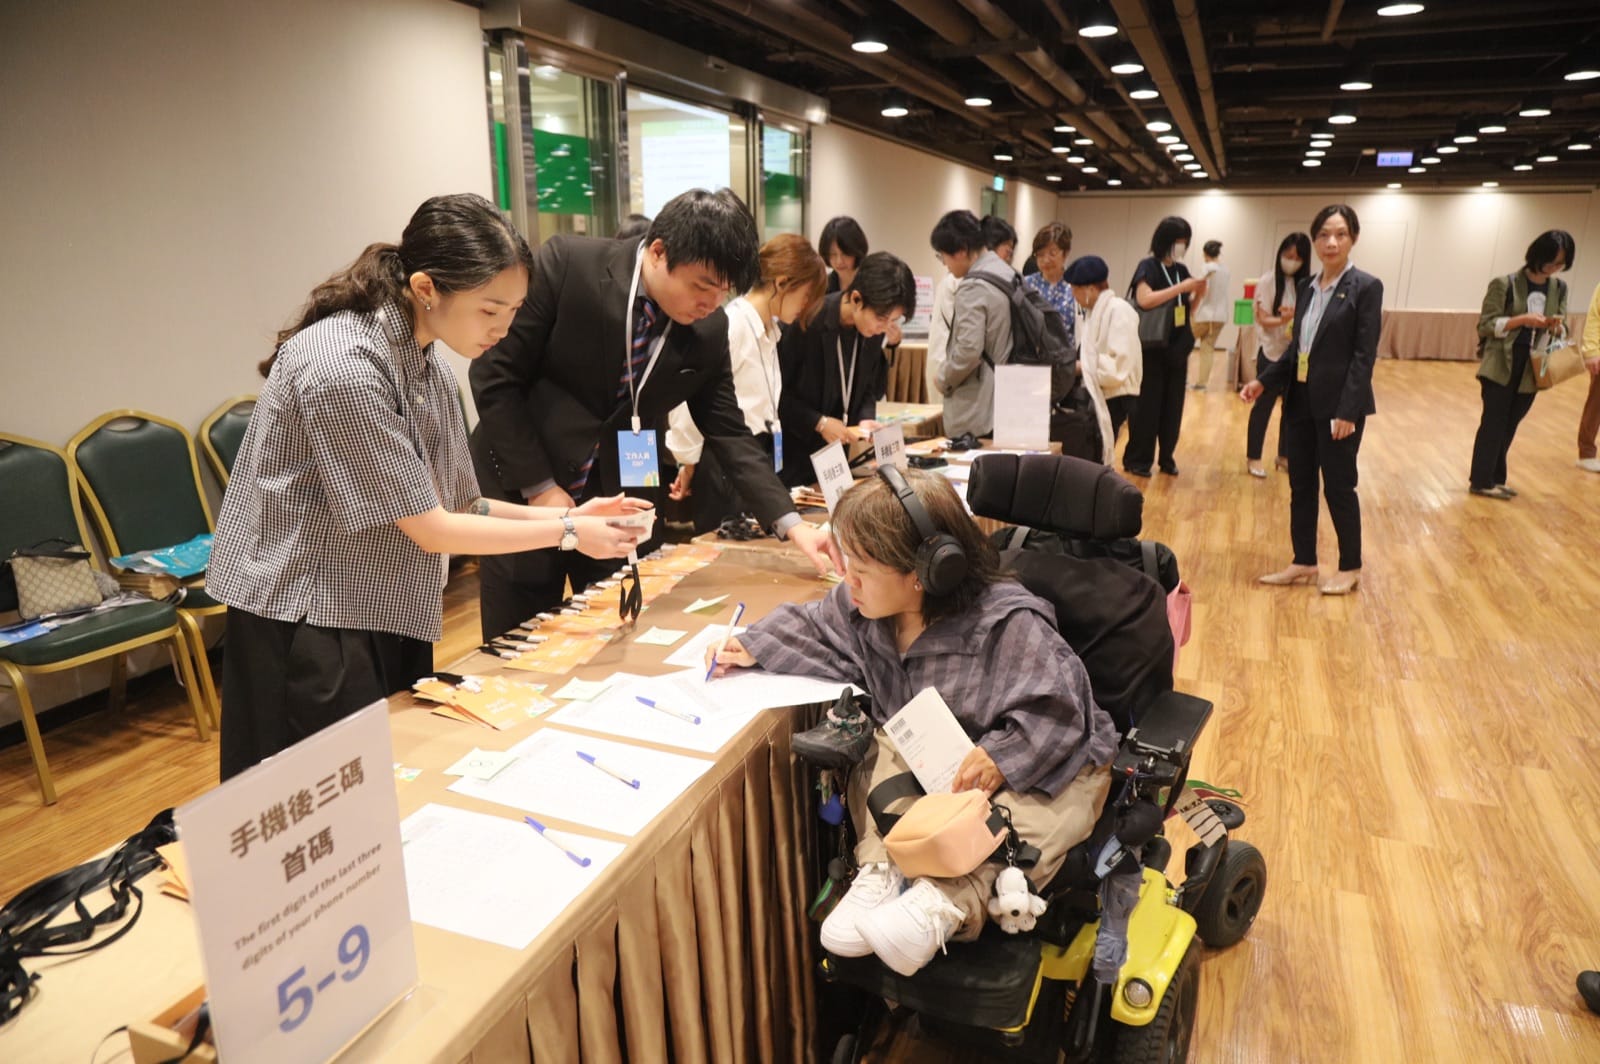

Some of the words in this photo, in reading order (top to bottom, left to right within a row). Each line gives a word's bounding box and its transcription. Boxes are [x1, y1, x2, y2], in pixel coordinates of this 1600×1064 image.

[230, 756, 364, 859] 手機後三碼
[281, 826, 334, 883] 首碼
[234, 932, 256, 950] The
[258, 913, 281, 934] first
[283, 894, 307, 917] digit
[309, 884, 319, 899] of
[321, 874, 337, 890] the
[338, 860, 356, 878] last
[357, 843, 381, 864] three
[242, 943, 274, 971] digits
[275, 930, 286, 945] of
[289, 914, 312, 938] your
[314, 891, 344, 919] phone
[346, 864, 381, 893] number
[276, 924, 370, 1033] 5-9
